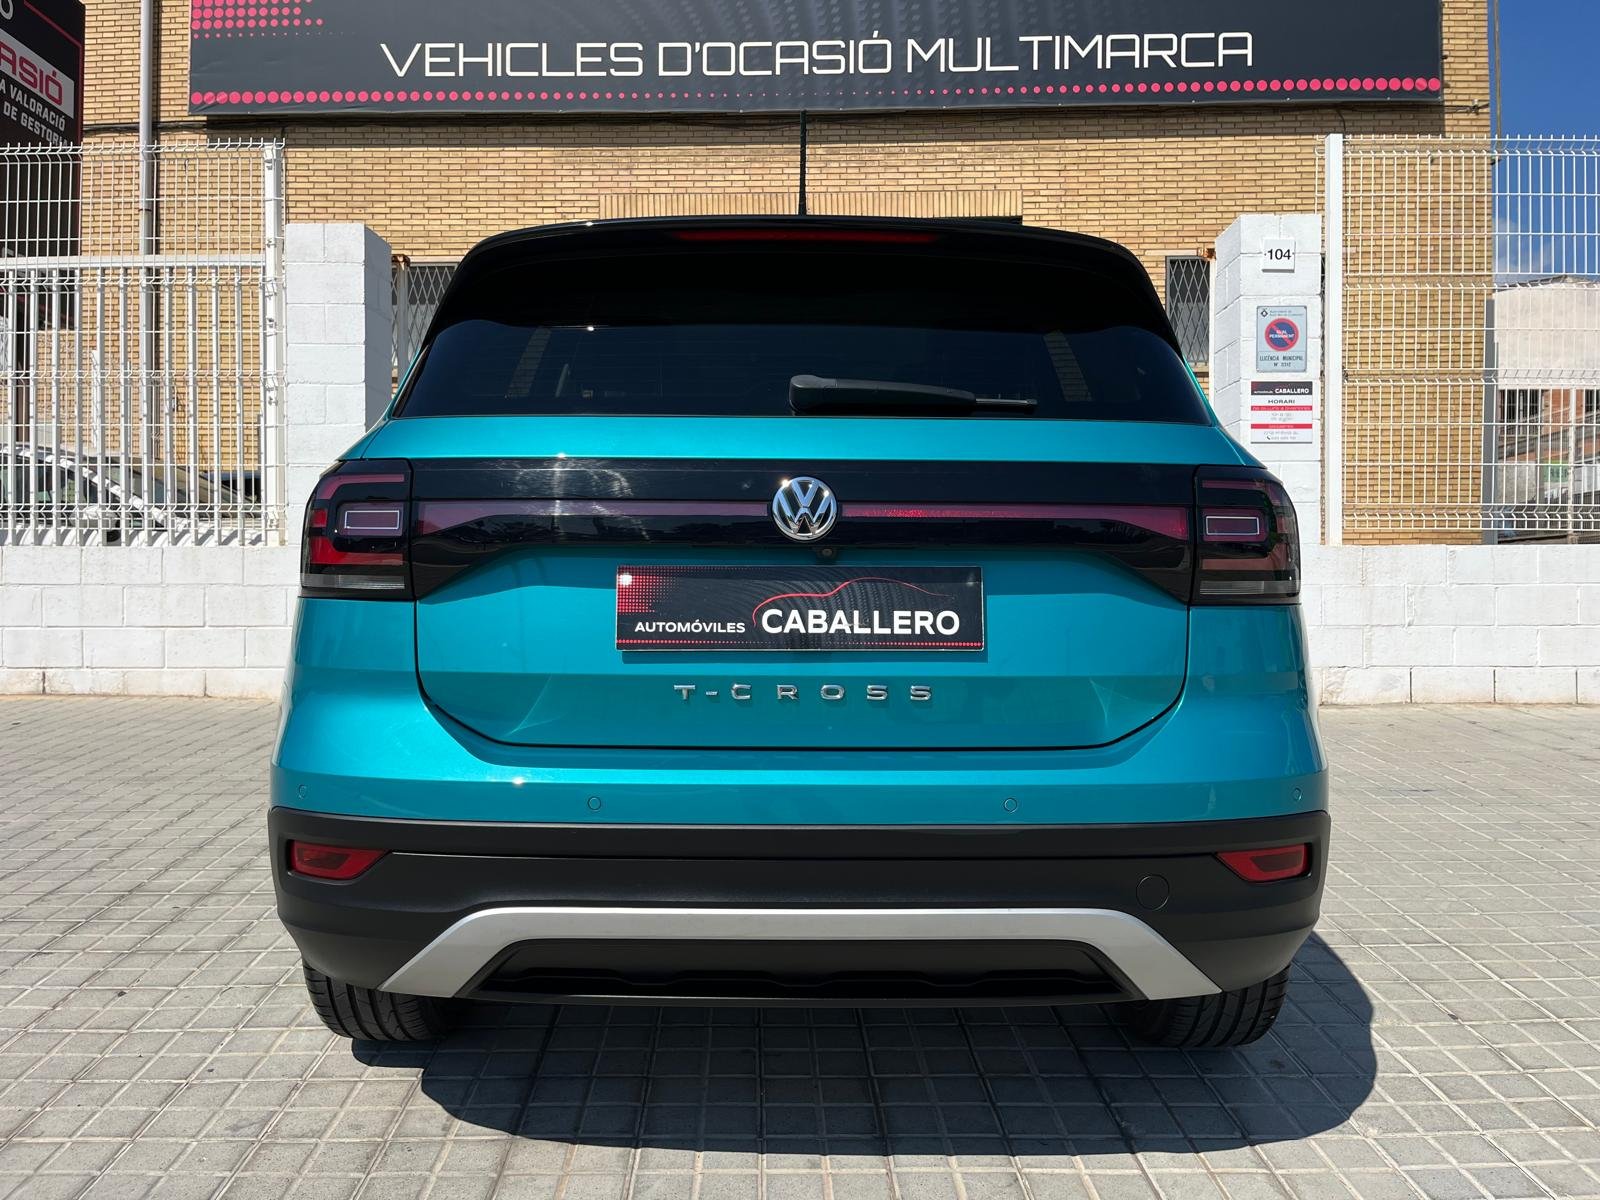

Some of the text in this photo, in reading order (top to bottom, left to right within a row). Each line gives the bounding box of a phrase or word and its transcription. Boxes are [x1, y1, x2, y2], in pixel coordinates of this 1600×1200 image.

[380, 30, 1253, 78] VEHICLES D'OCASIÓ MULTIMARCA
[3, 101, 18, 122] DE
[10, 84, 66, 131] VALORACIÓ
[1267, 248, 1292, 261] 104
[634, 608, 961, 636] AUTOMÓVILES CABALLERO
